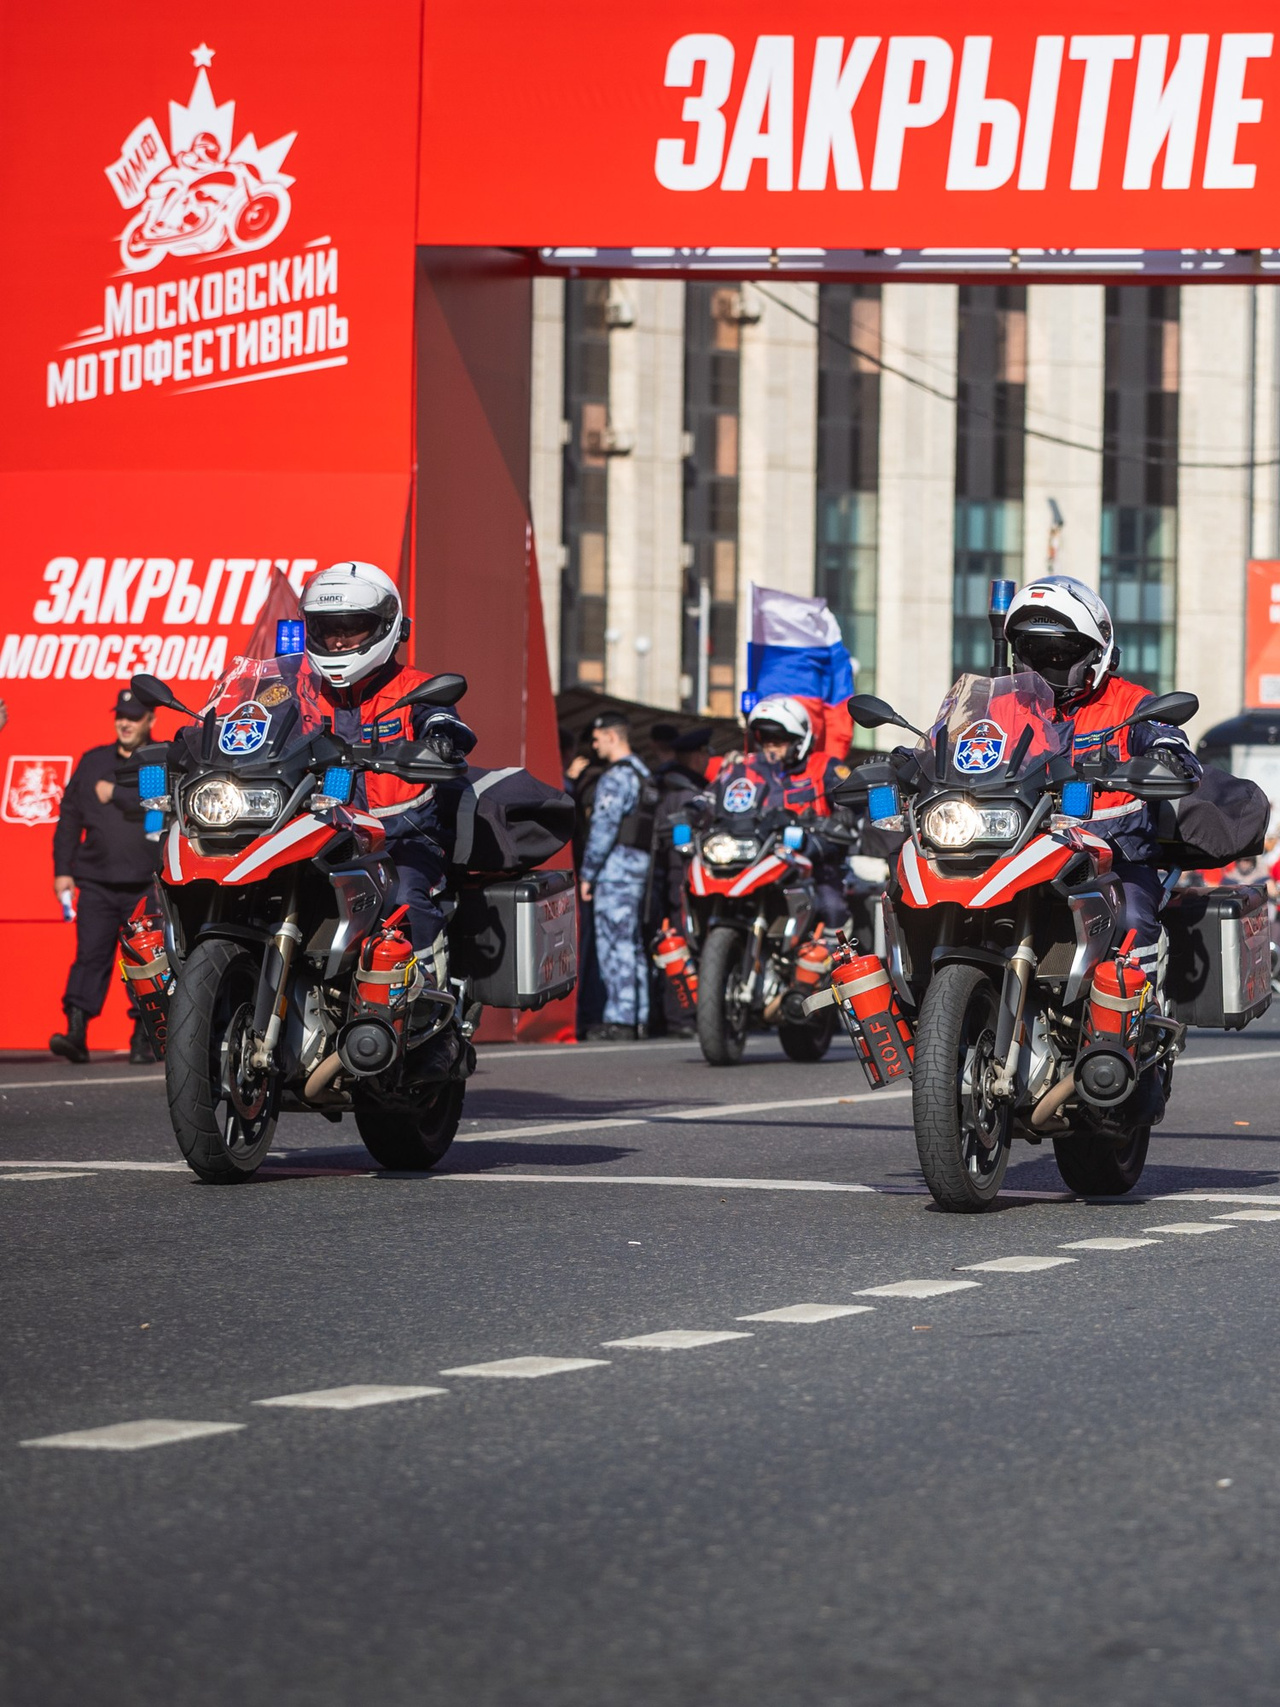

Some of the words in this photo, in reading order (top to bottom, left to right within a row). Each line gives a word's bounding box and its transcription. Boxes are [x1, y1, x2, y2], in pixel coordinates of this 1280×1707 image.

[654, 32, 1275, 193] ЗАКРЫТИЕ
[115, 132, 158, 200] ММФ
[46, 303, 349, 408] МОТОФЕСТИВАЛЬ
[0, 634, 229, 681] МОТОСЕЗОНА
[869, 1021, 905, 1078] ROLF
